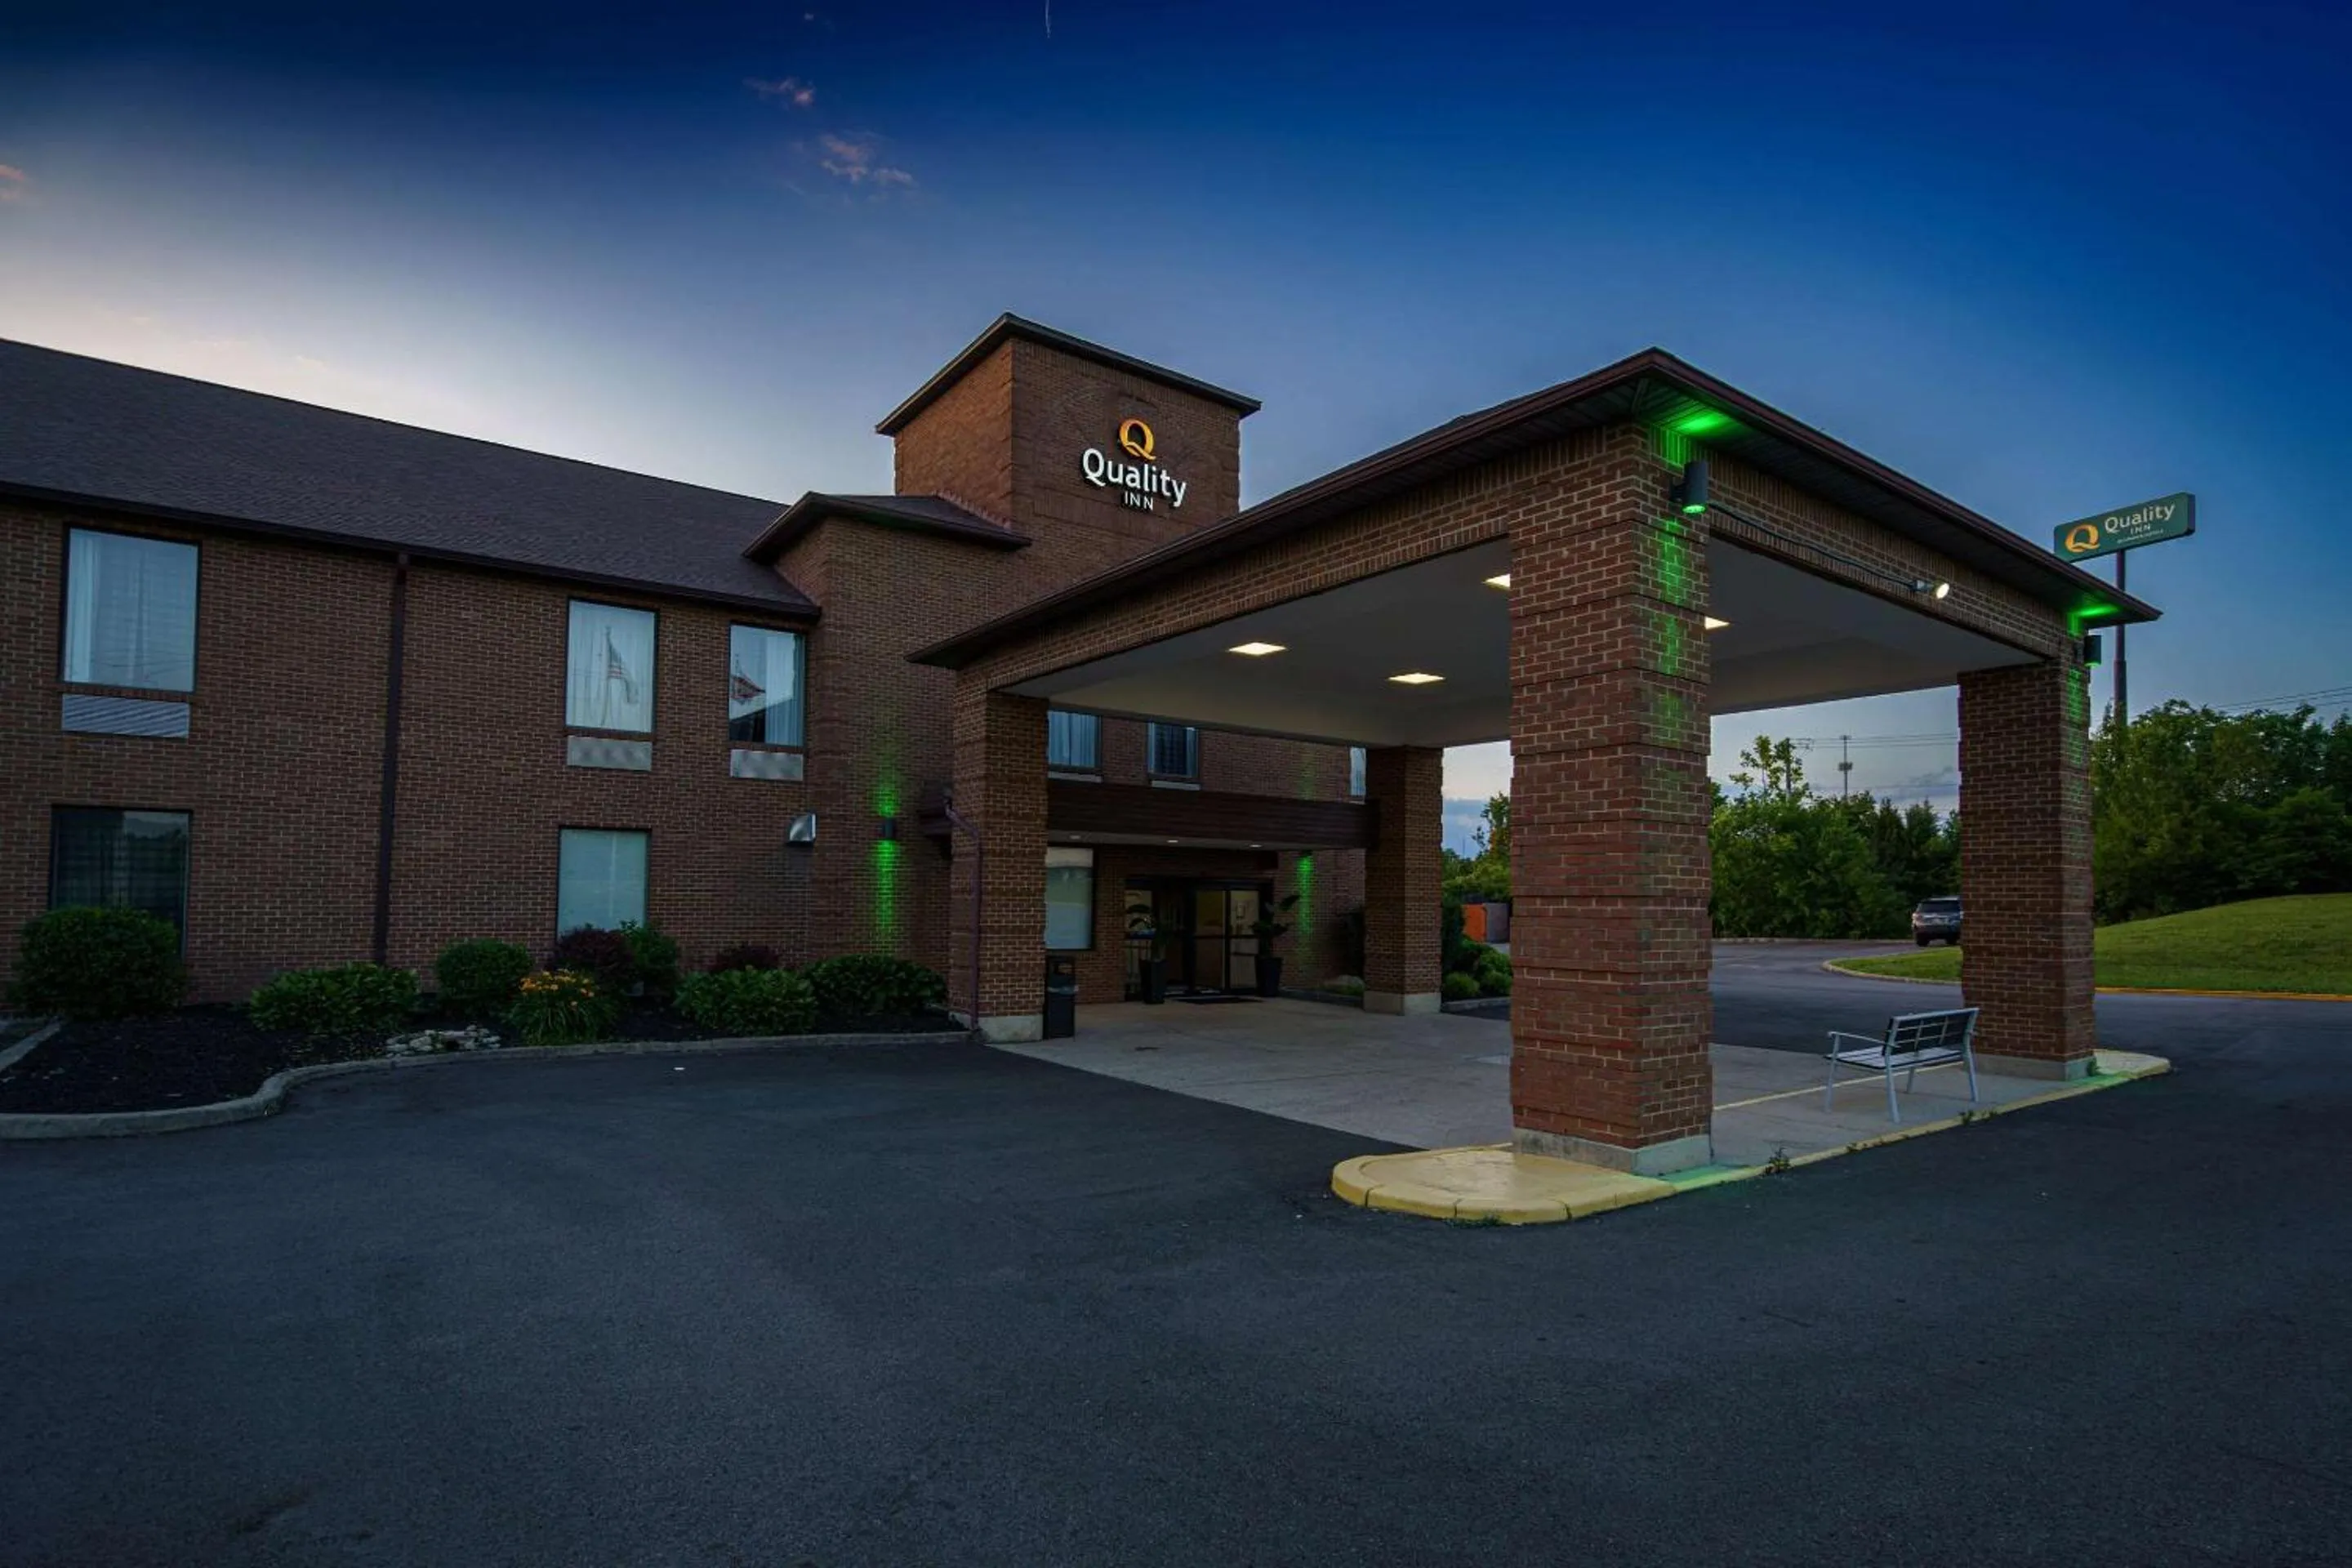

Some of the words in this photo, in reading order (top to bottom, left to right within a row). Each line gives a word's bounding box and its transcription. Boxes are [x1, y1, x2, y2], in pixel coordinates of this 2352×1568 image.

[1119, 420, 1156, 460] Q
[1082, 448, 1187, 507] Quality
[1124, 491, 1154, 510] INN
[2105, 503, 2175, 533] Quality
[2130, 523, 2151, 535] INN
[2065, 523, 2100, 553] Q
